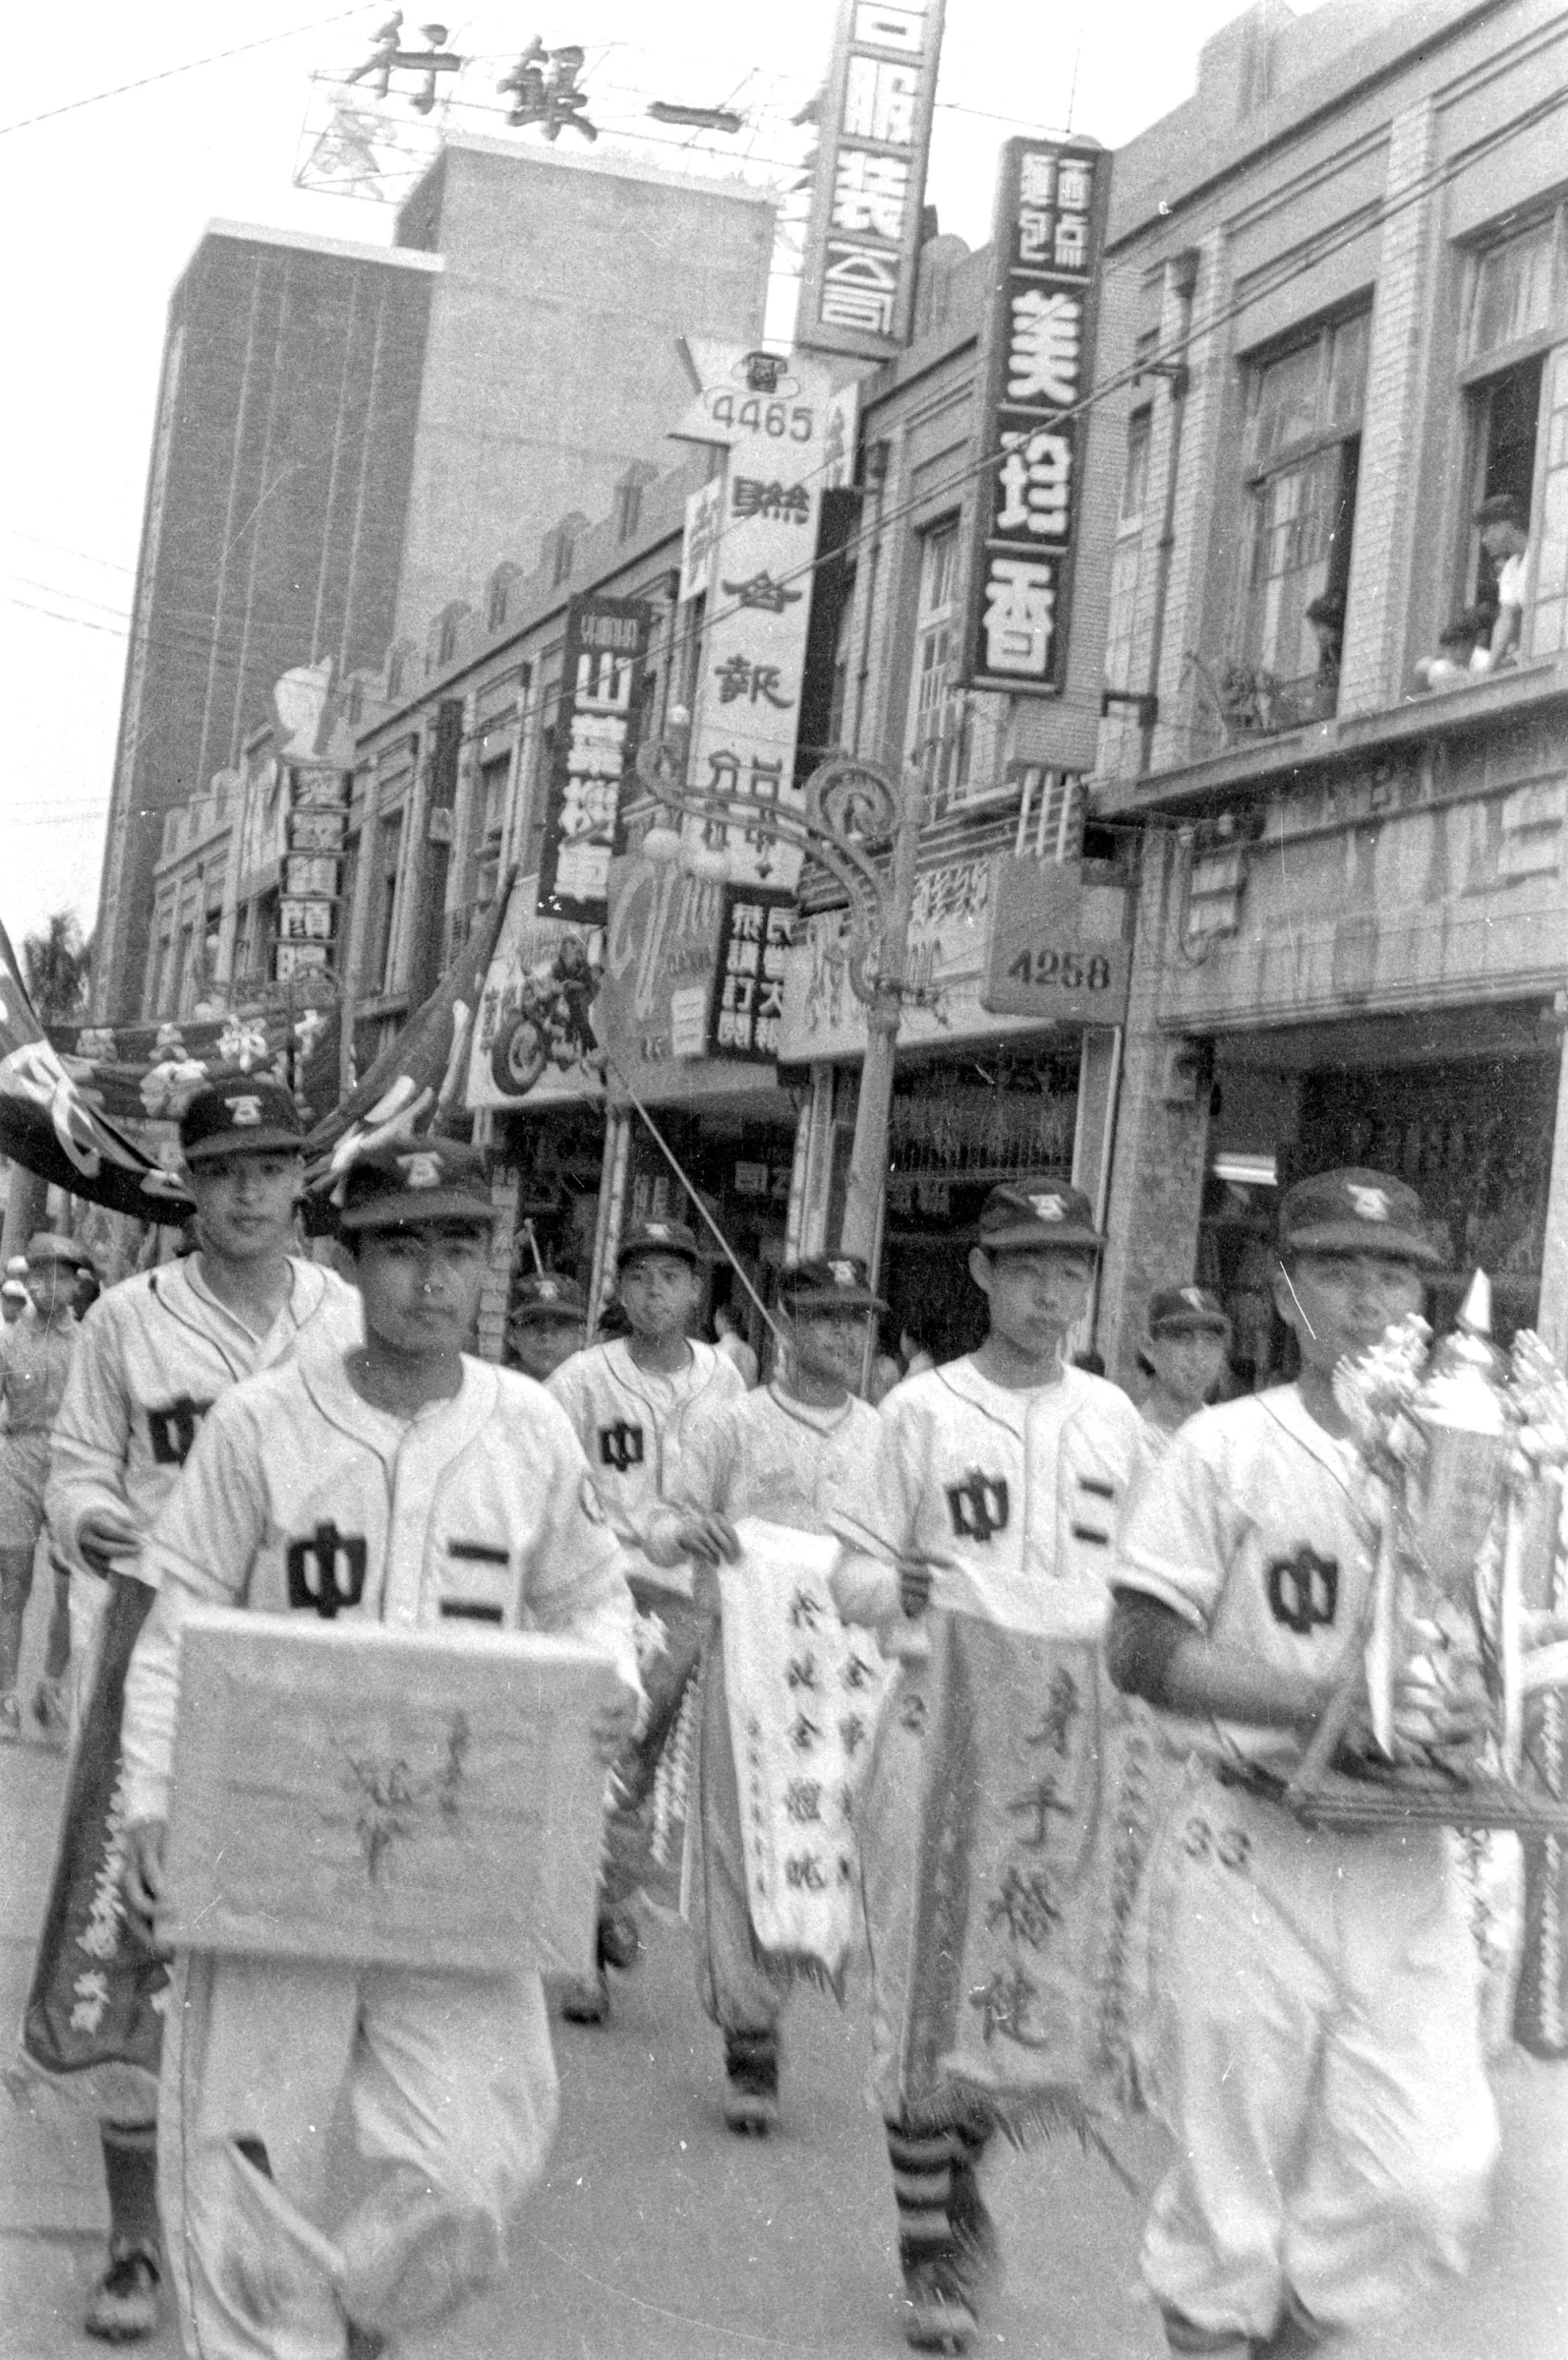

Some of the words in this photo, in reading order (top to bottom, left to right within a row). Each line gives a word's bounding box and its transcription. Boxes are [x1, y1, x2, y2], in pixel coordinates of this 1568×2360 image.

[712, 393, 815, 443] 4465
[1007, 947, 1112, 991] 4258
[599, 1420, 645, 1472] 中
[946, 1467, 1010, 1543] 中
[285, 1518, 368, 1619] 中
[439, 1537, 510, 1623] 二
[1266, 1538, 1340, 1636] 中
